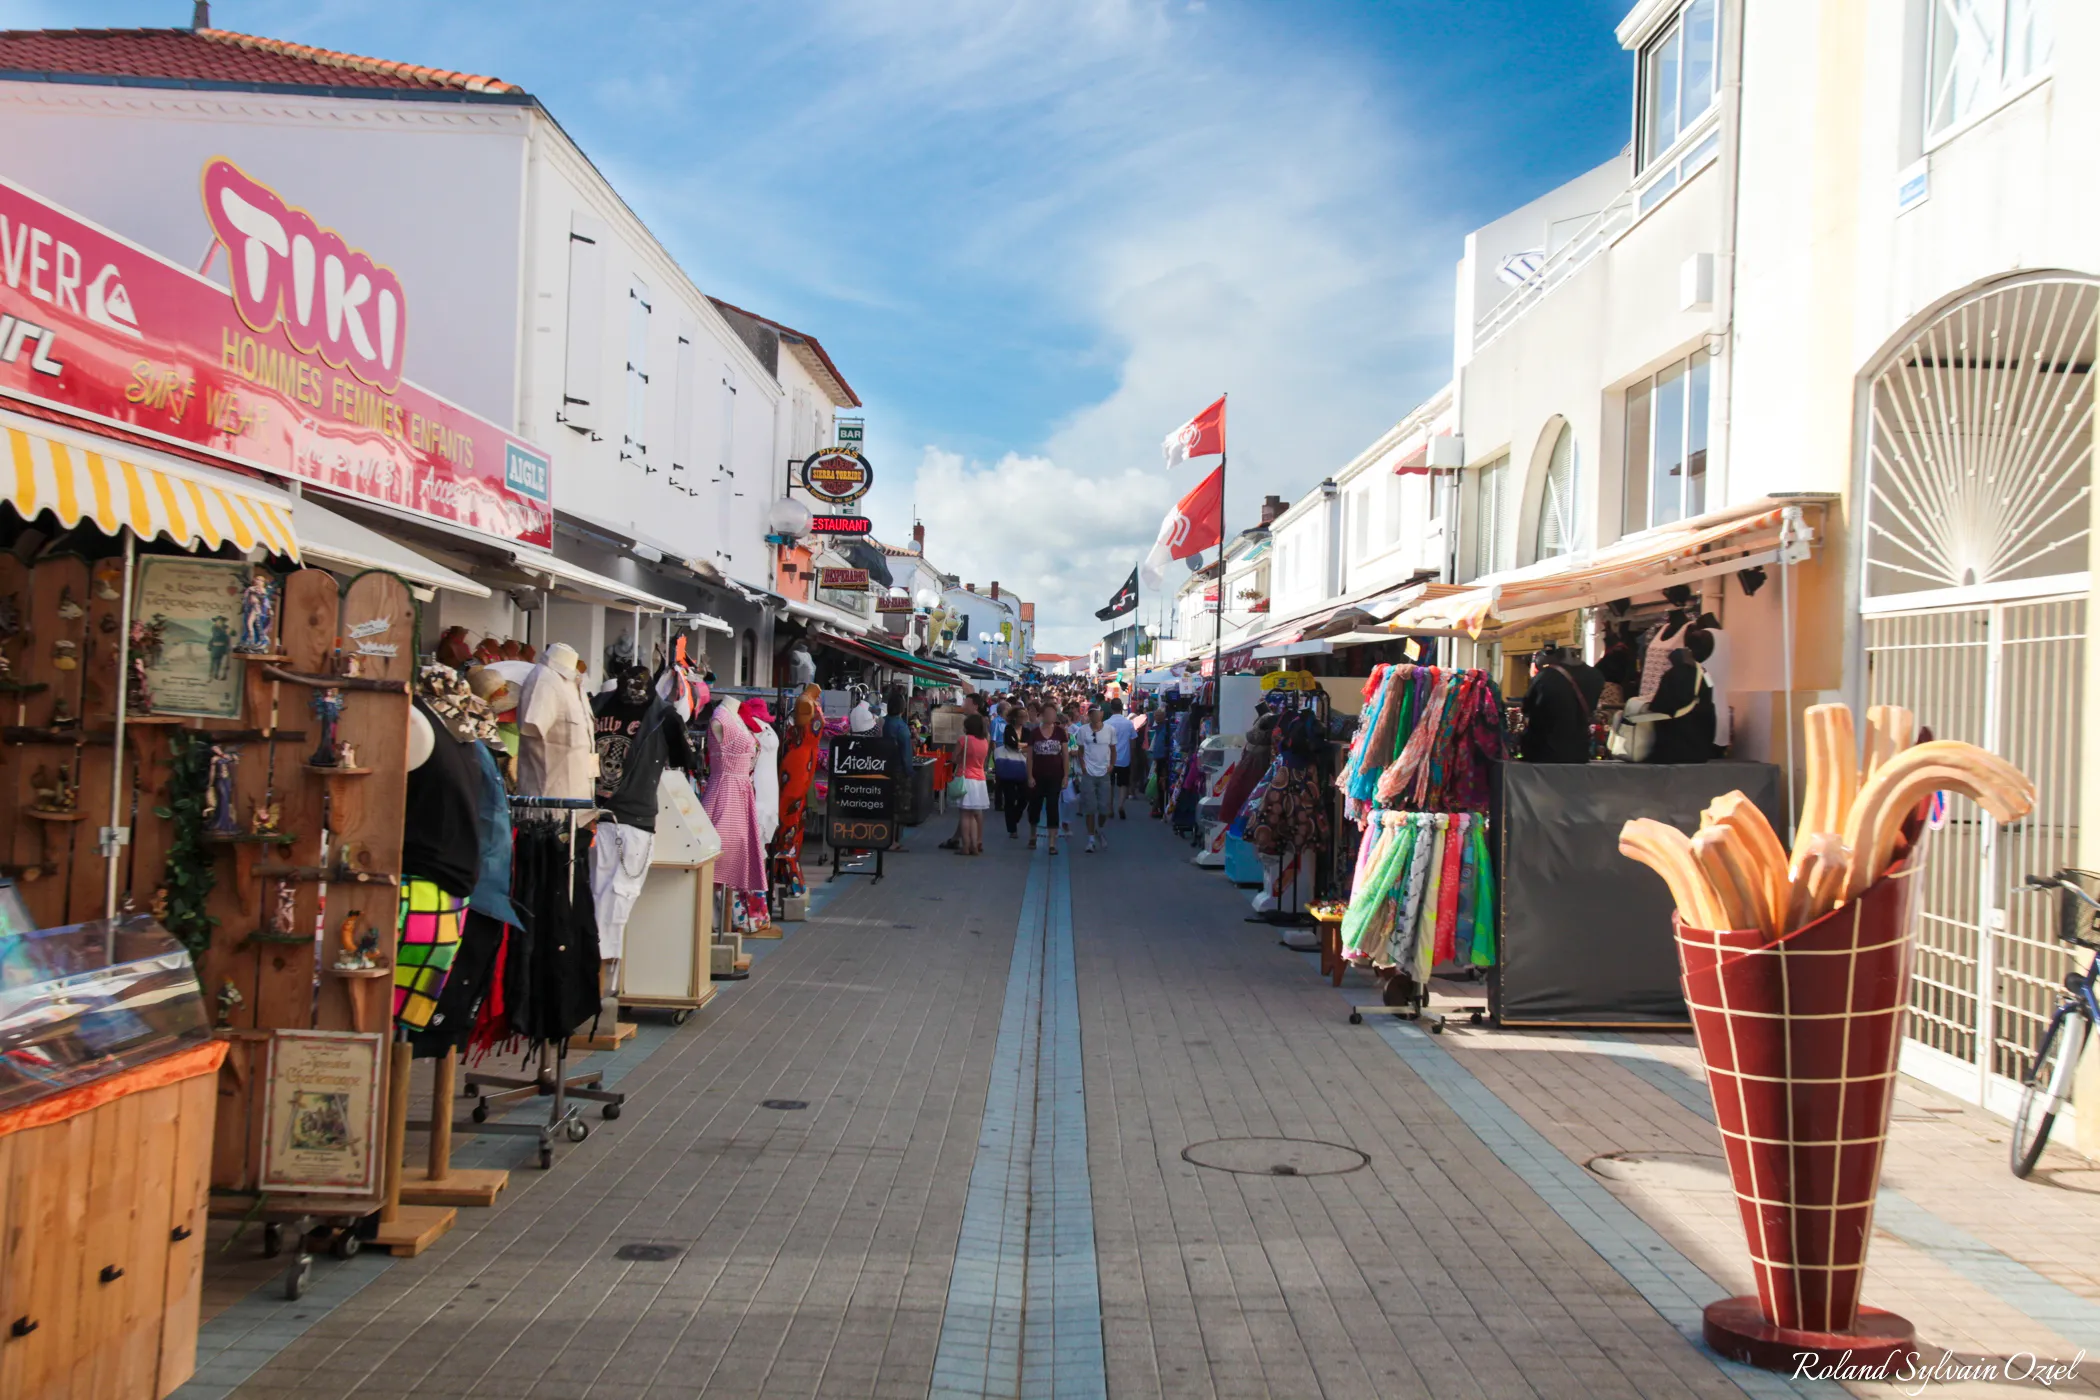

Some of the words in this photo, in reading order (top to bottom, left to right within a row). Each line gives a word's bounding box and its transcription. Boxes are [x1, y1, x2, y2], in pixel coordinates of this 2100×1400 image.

[221, 187, 397, 370] TIKI
[125, 360, 196, 420] SURF
[223, 326, 322, 409] HOMMES
[332, 377, 404, 442] FEMMES
[411, 413, 474, 470] ENFANTS
[840, 430, 861, 438] BAR
[819, 447, 859, 458] PIZZAS
[509, 454, 546, 493] AIGLE
[813, 469, 835, 479] SIERRA
[824, 568, 866, 582] DESPERADOS
[844, 785, 882, 795] Portraits
[840, 799, 884, 810] Mariages
[833, 822, 888, 840] PHOTO
